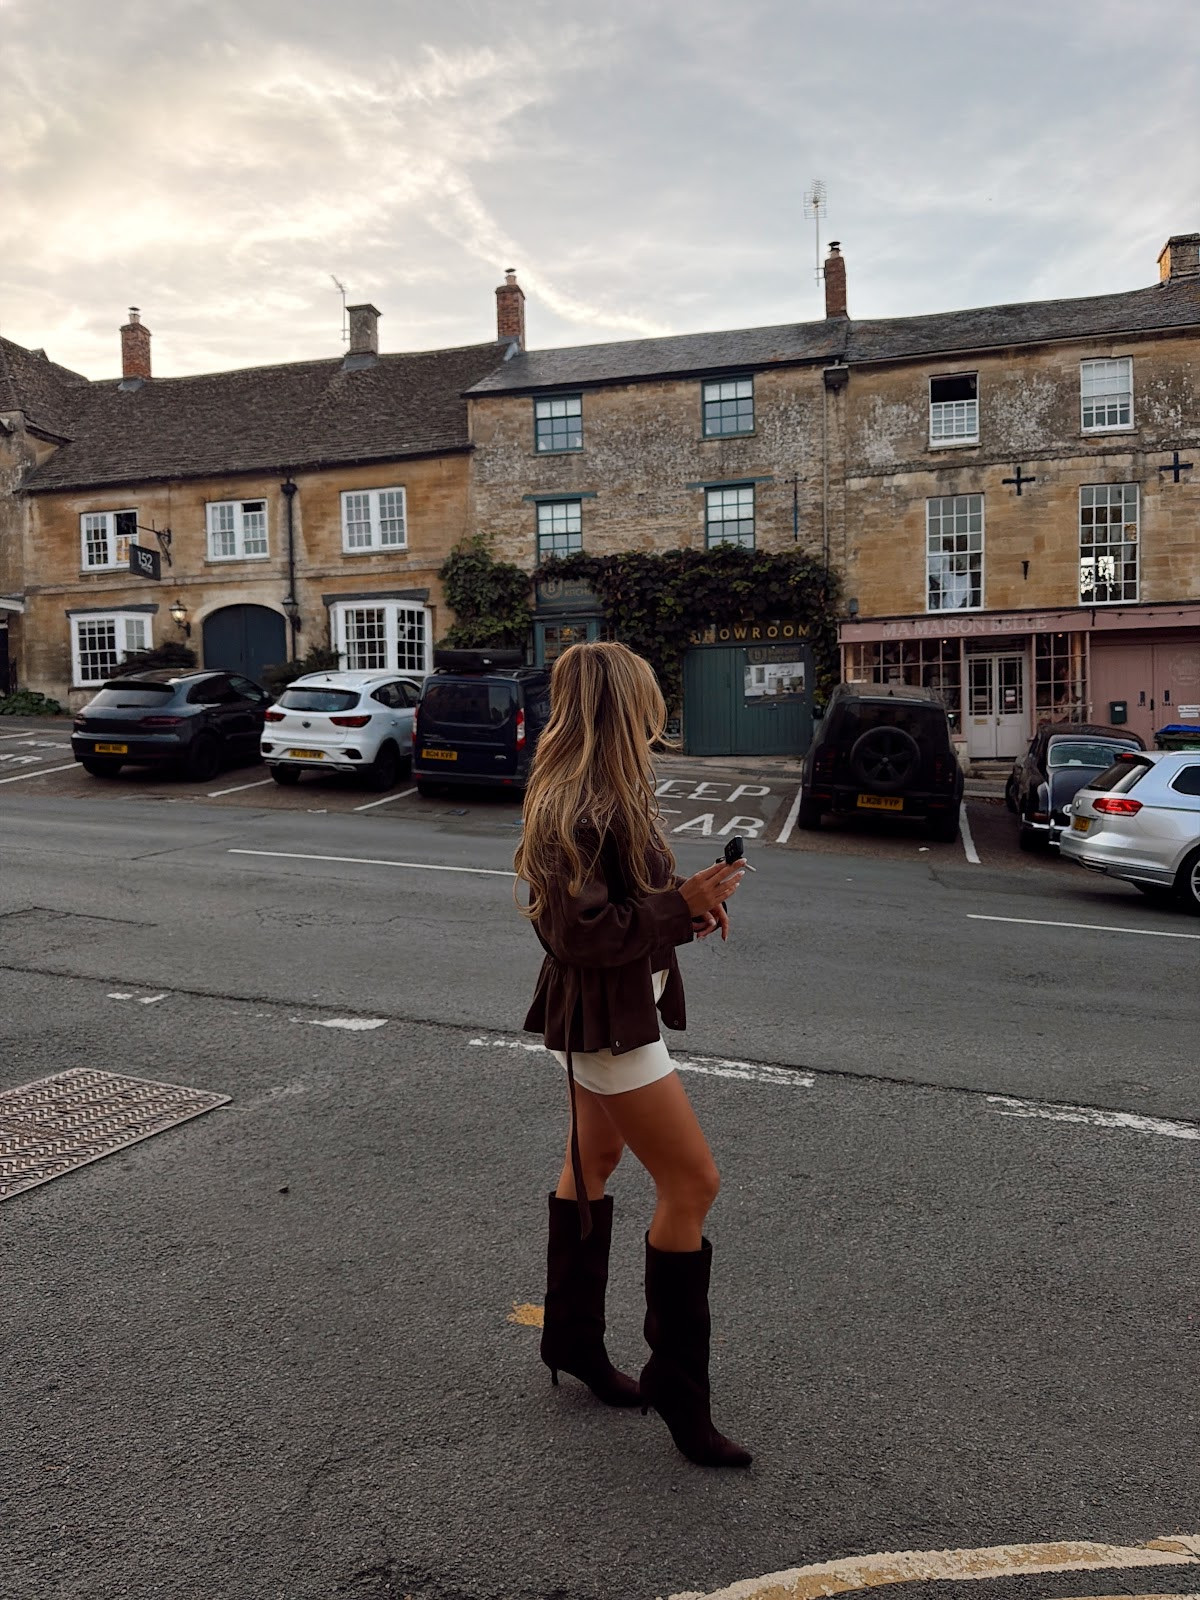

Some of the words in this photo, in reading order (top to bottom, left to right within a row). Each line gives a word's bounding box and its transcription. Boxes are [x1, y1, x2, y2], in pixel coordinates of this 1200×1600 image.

[137, 551, 153, 568] 152
[689, 624, 811, 644] SHOWROOM
[882, 623, 911, 637] MA
[914, 618, 986, 635] MAISON
[990, 616, 1047, 632] BELLE
